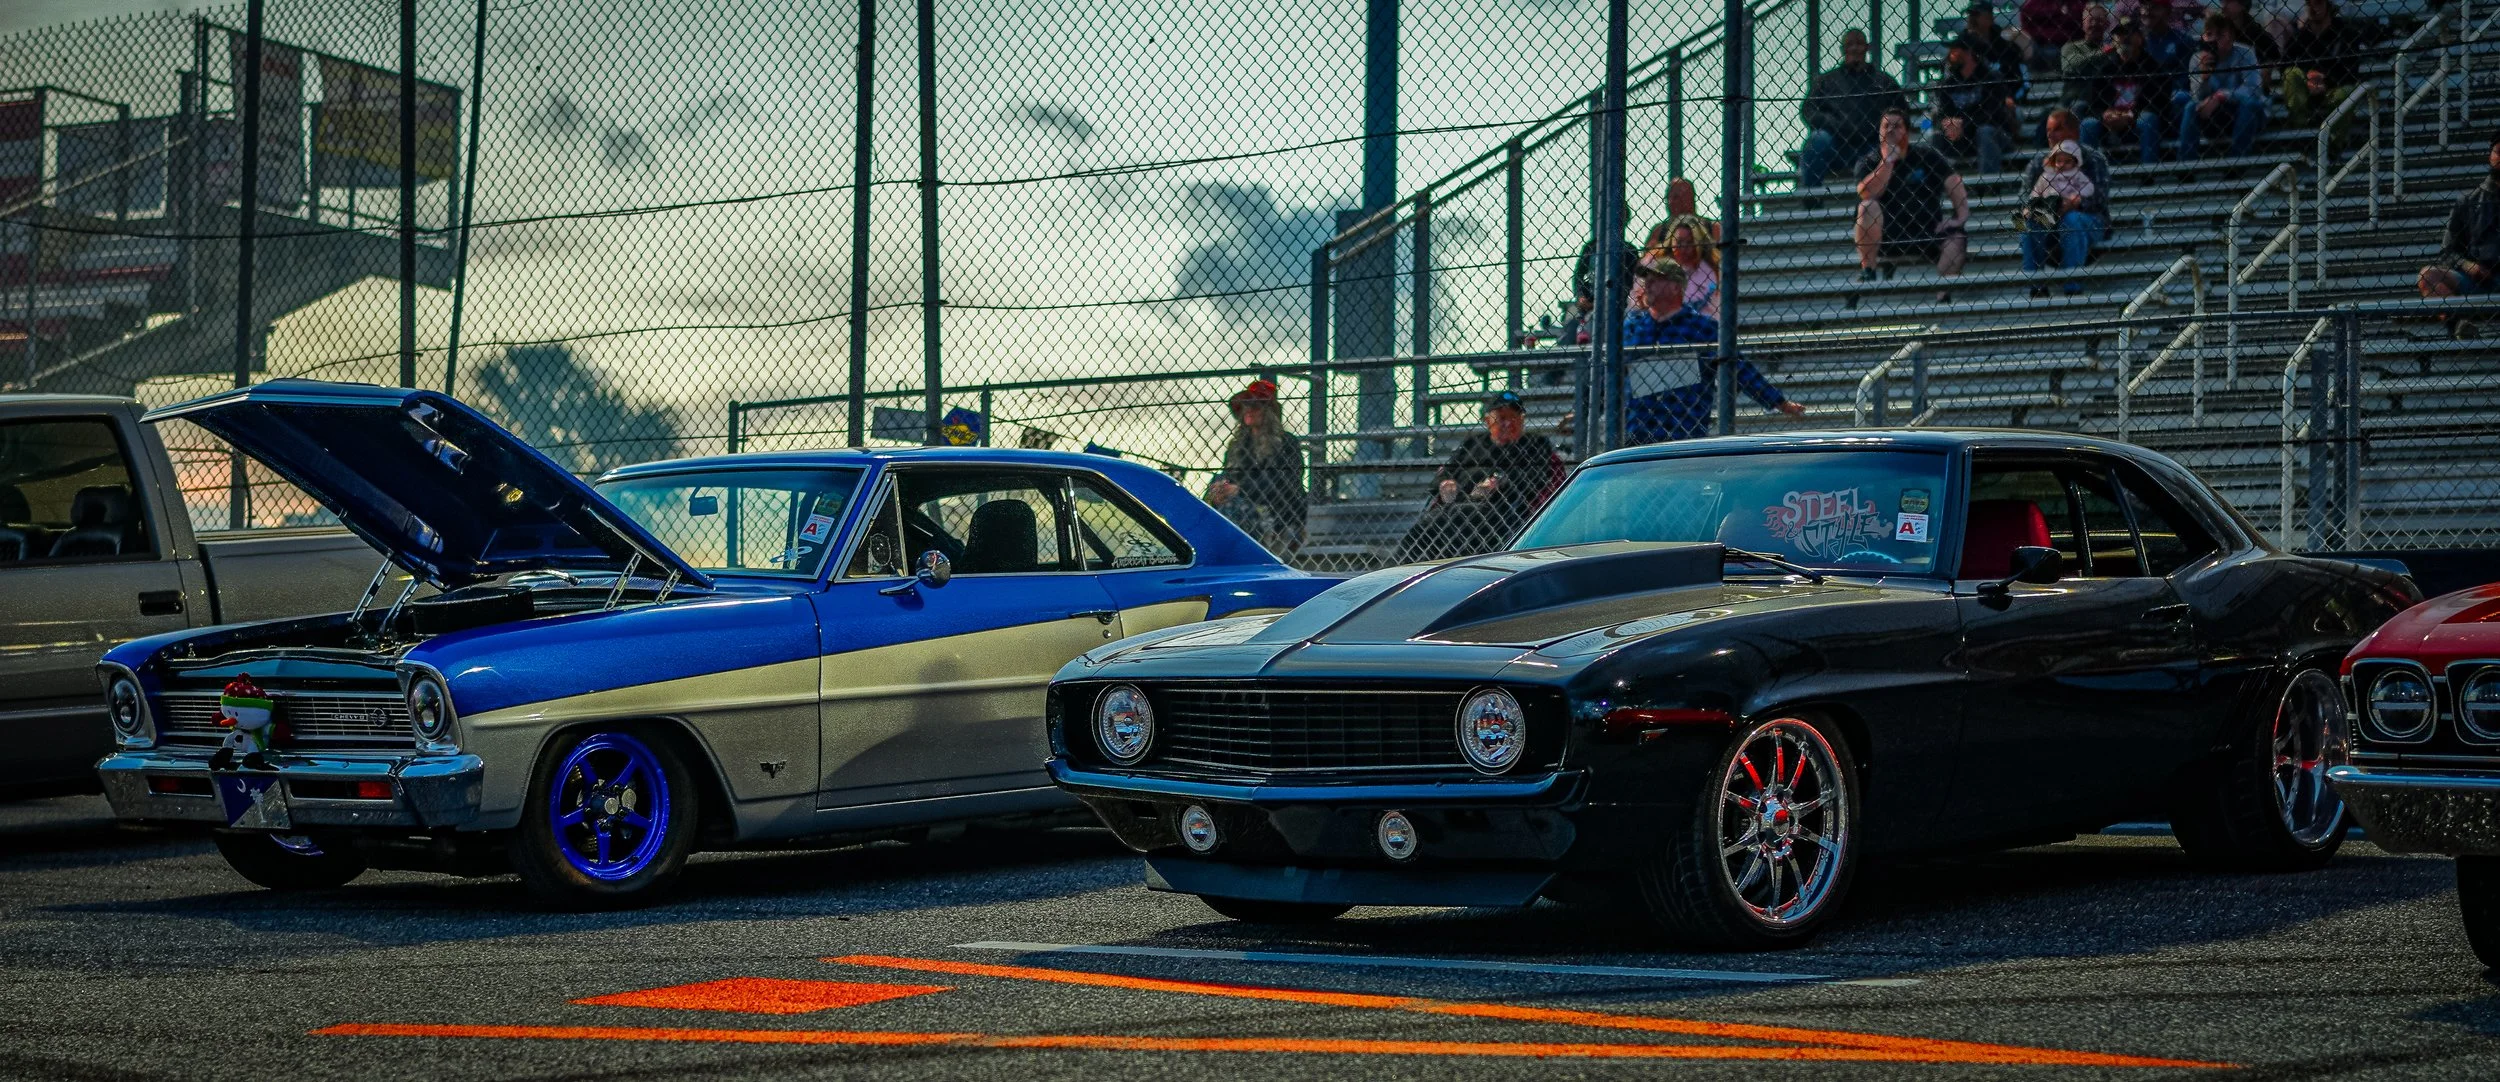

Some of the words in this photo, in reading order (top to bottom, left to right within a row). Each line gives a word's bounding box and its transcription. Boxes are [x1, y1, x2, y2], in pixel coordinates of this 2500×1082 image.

[1781, 487, 1874, 525] STEEL
[1785, 520, 1799, 543] &
[1801, 511, 1880, 560] STYLE
[1899, 521, 1915, 534] A
